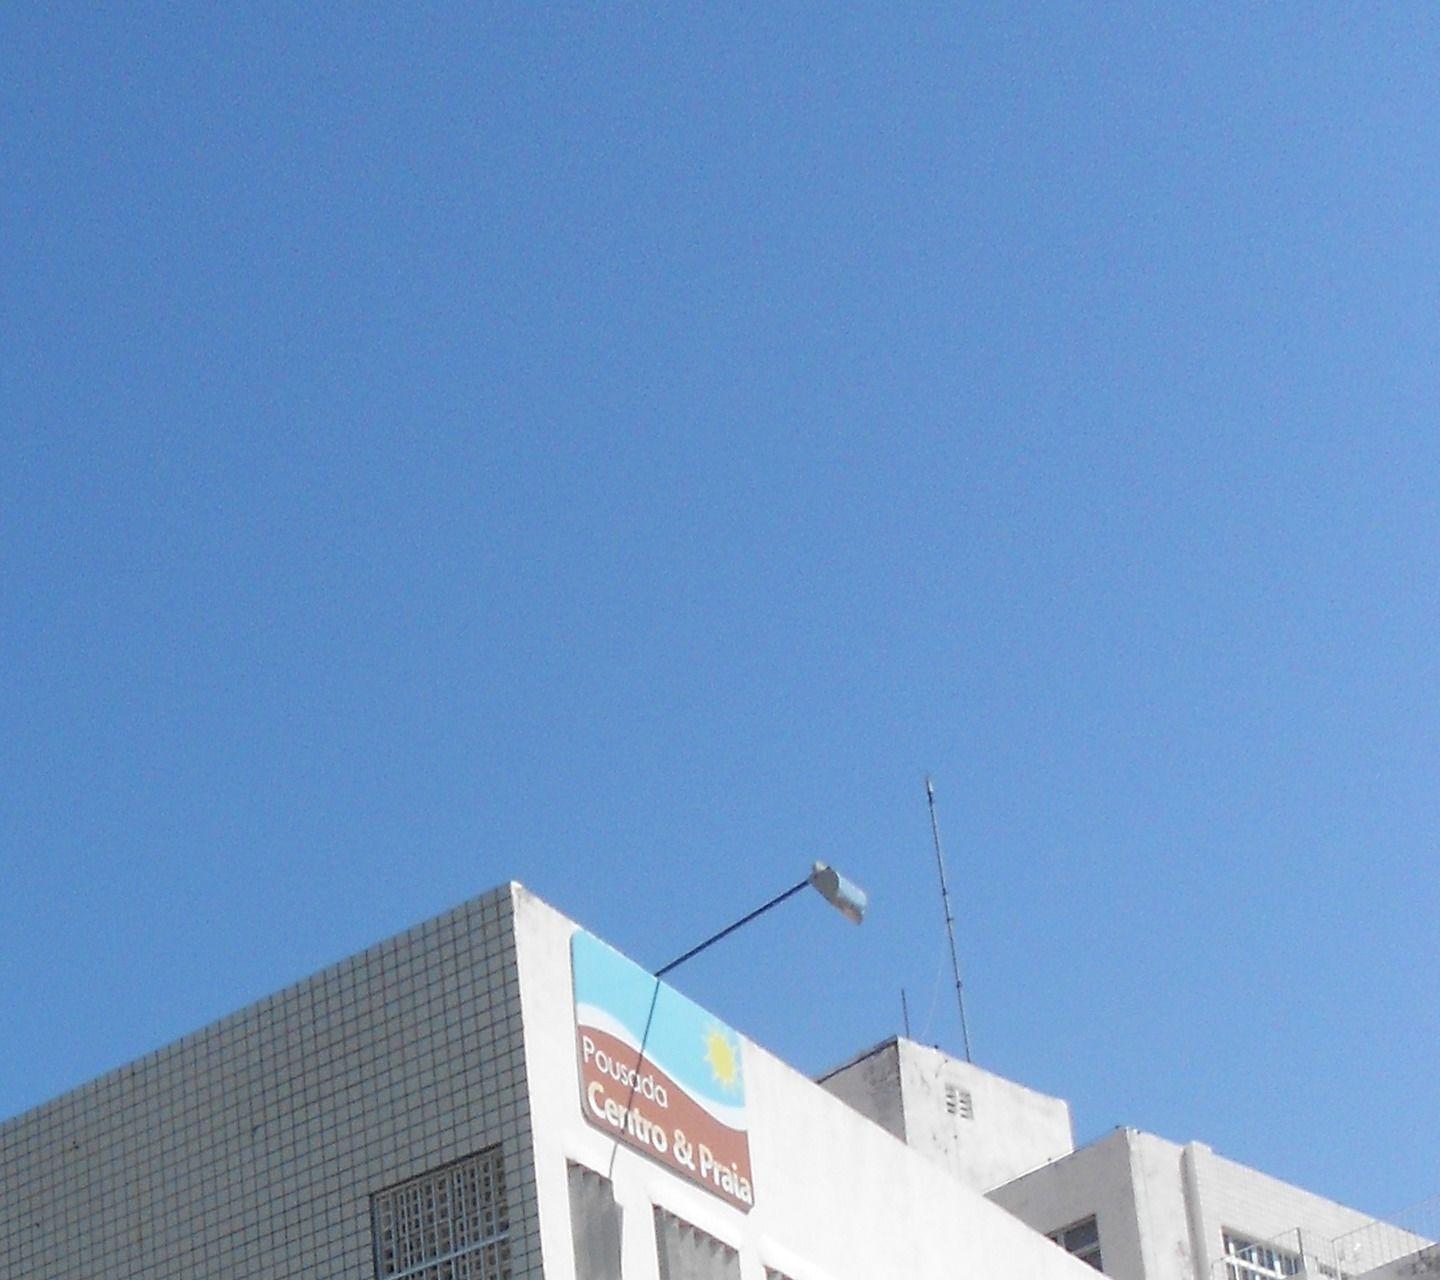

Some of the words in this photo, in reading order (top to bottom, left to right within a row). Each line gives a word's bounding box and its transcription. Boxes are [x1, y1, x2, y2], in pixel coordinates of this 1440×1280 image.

[582, 1035, 669, 1109] Pousada
[587, 1080, 669, 1153] Centro
[673, 1129, 696, 1171] &
[699, 1143, 753, 1205] Praia
